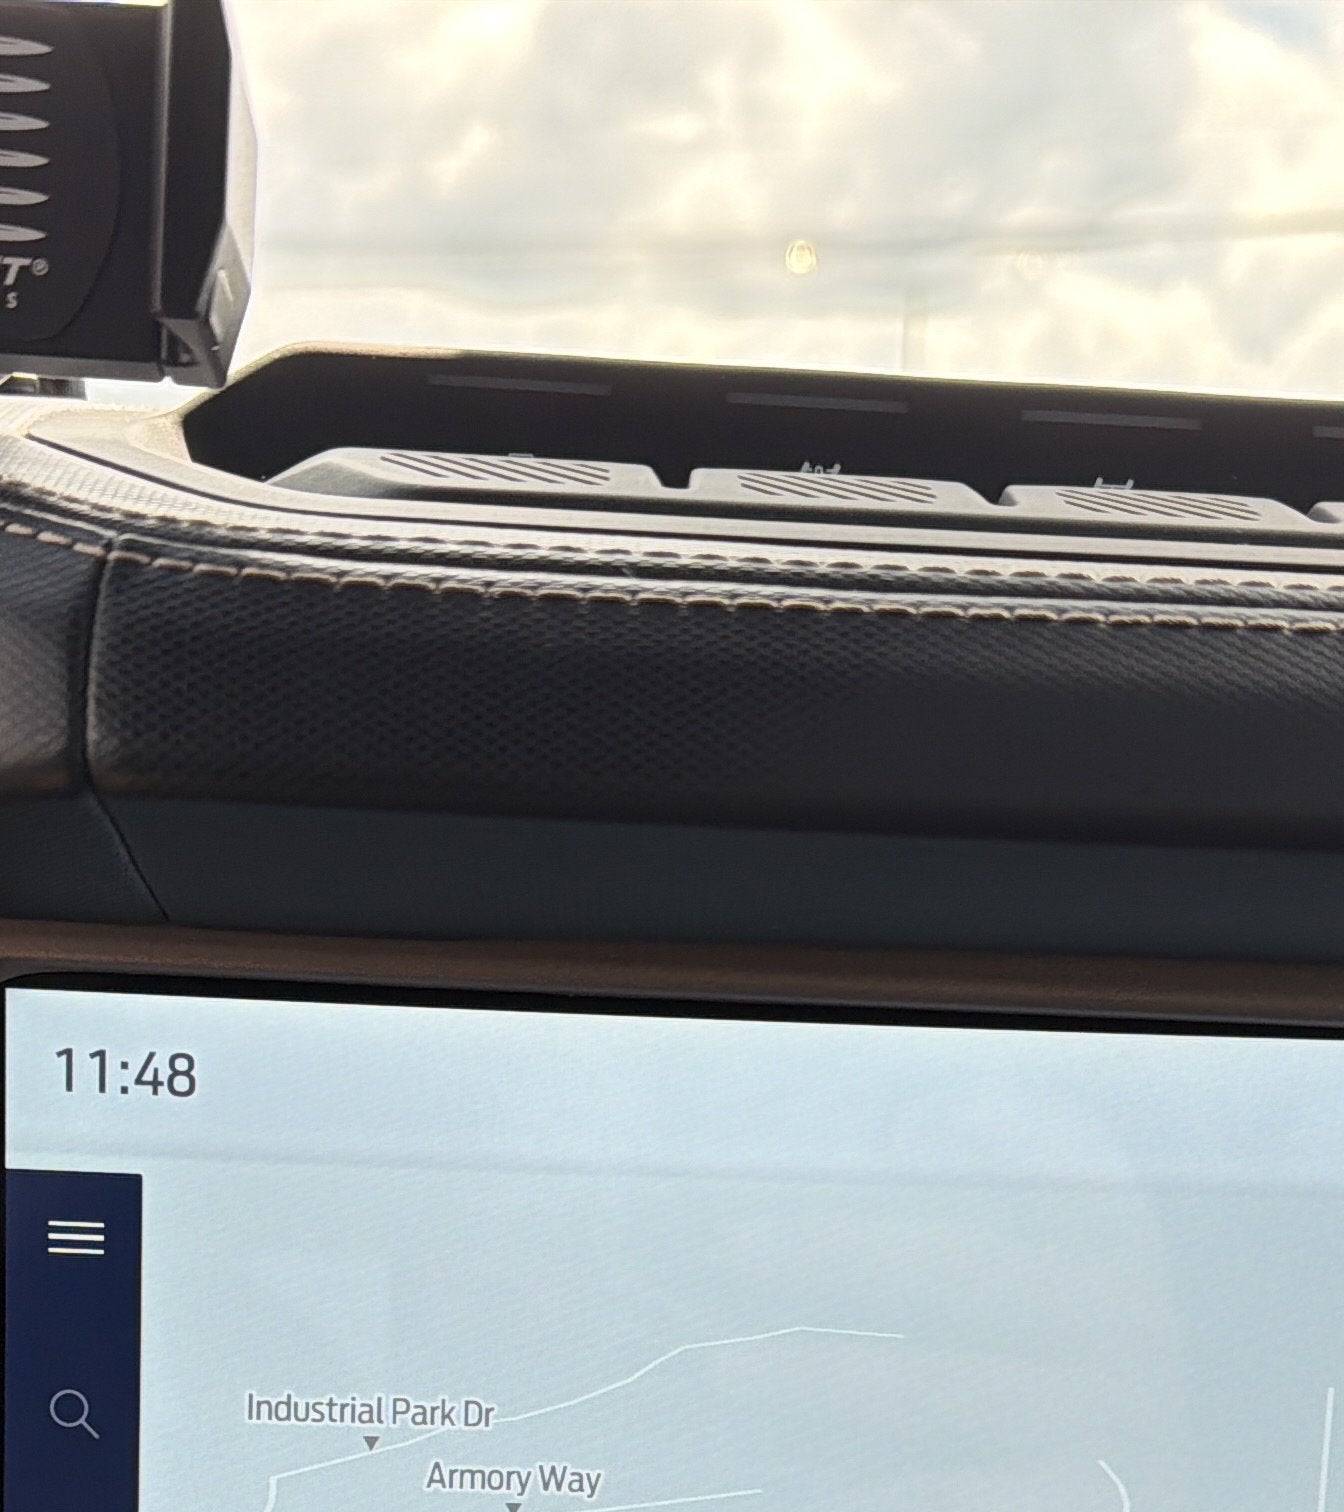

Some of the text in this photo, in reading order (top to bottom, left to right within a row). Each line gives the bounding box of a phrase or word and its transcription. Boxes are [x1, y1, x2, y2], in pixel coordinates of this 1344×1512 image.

[55, 1047, 197, 1097] 11:48
[246, 1393, 495, 1429] Industrial Park Dr
[426, 1461, 602, 1499] Armory Way
